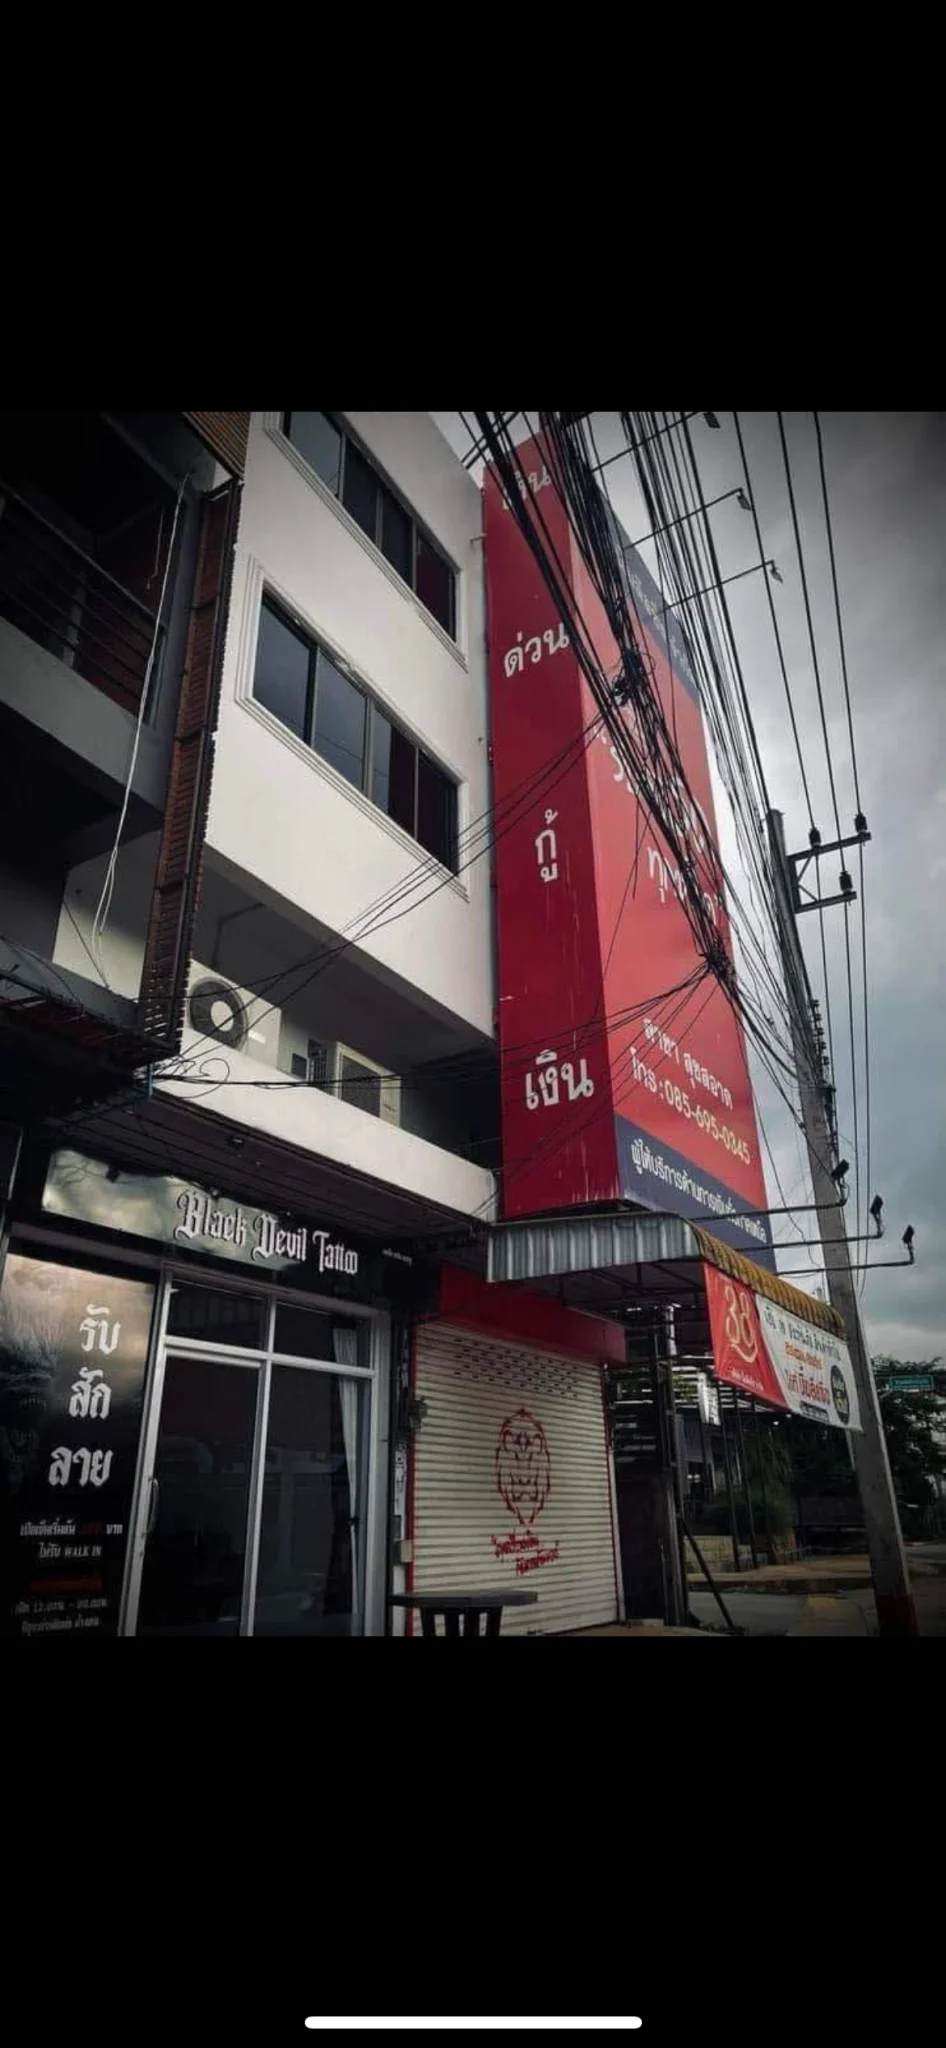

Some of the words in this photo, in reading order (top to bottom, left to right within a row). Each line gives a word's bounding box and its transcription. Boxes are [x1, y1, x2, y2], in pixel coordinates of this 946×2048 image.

[503, 622, 570, 678] ด่วน
[534, 808, 559, 883] กู้
[525, 1049, 595, 1110] เงิน
[174, 1187, 247, 1247] Black
[252, 1212, 307, 1262] Devil
[312, 1229, 359, 1275] Tattoo
[79, 1303, 122, 1356] รับ
[69, 1366, 112, 1420] สัก
[48, 1445, 114, 1487] ลาย
[64, 1545, 89, 1558] WALK
[91, 1545, 102, 1557] IN
